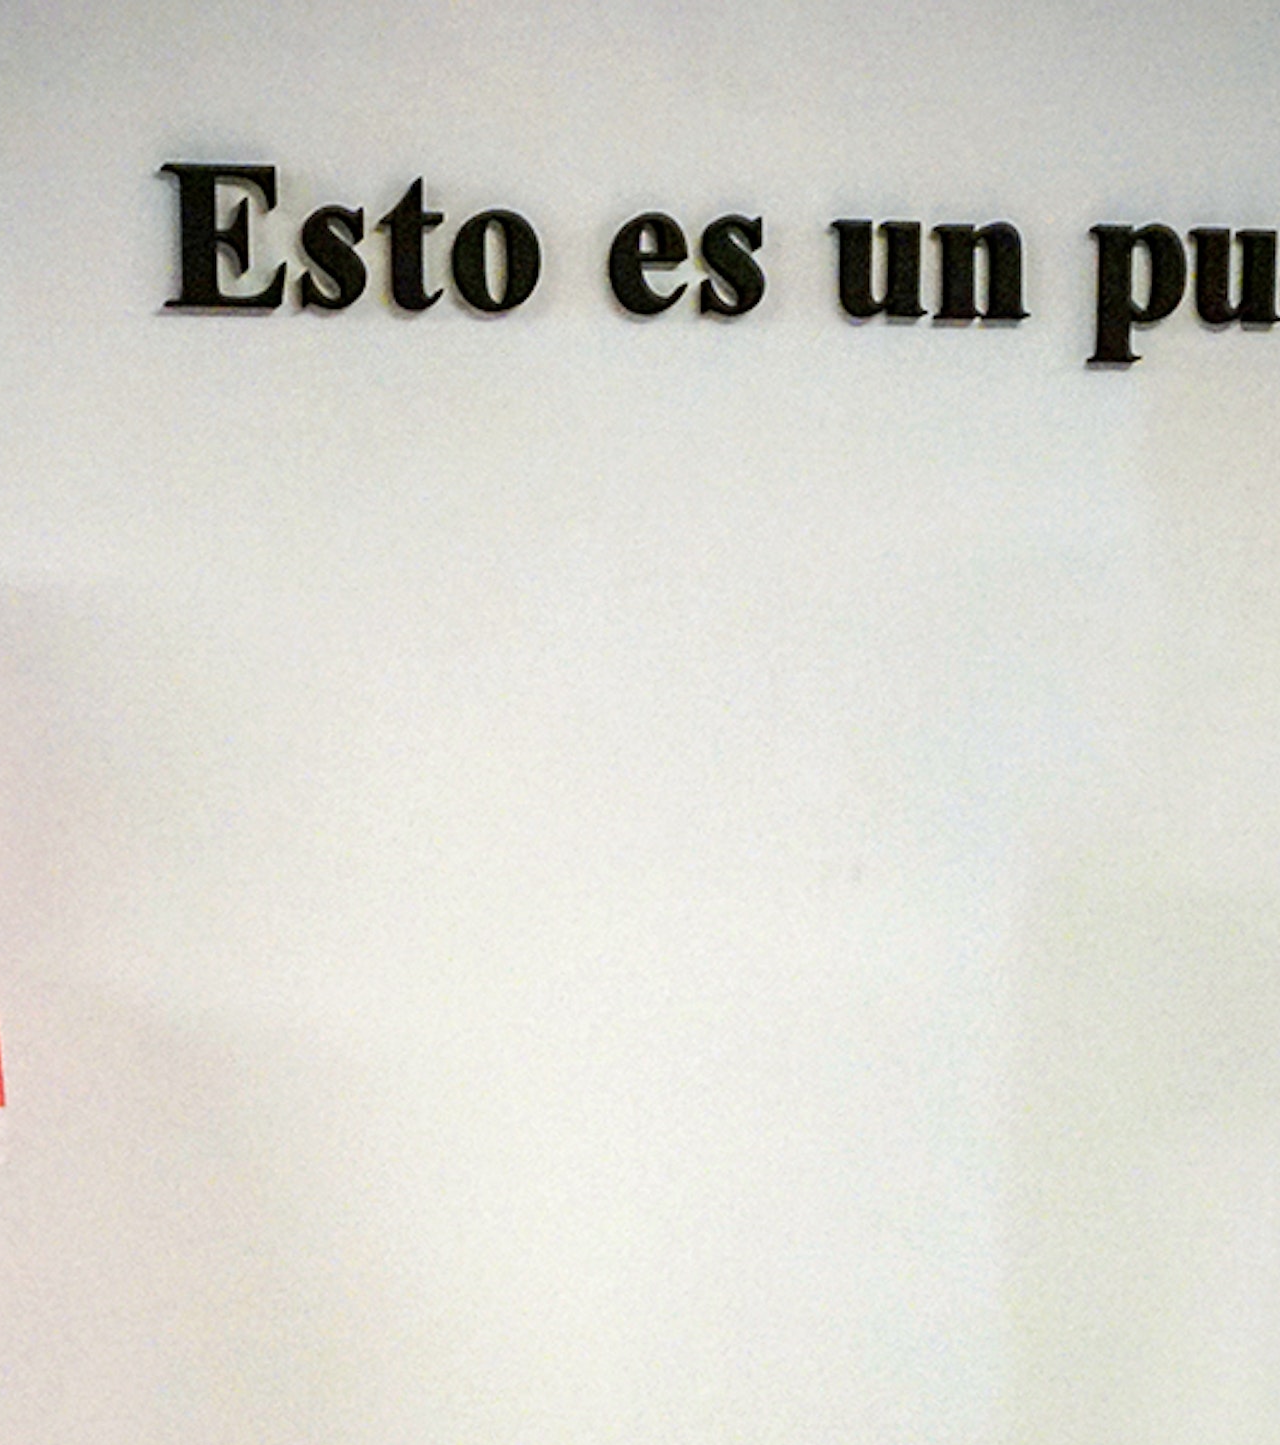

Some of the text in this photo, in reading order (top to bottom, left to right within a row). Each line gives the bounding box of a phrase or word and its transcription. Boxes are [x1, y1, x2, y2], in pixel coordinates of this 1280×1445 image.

[161, 163, 541, 313] Esto
[609, 212, 765, 316] es
[830, 218, 1030, 320] un
